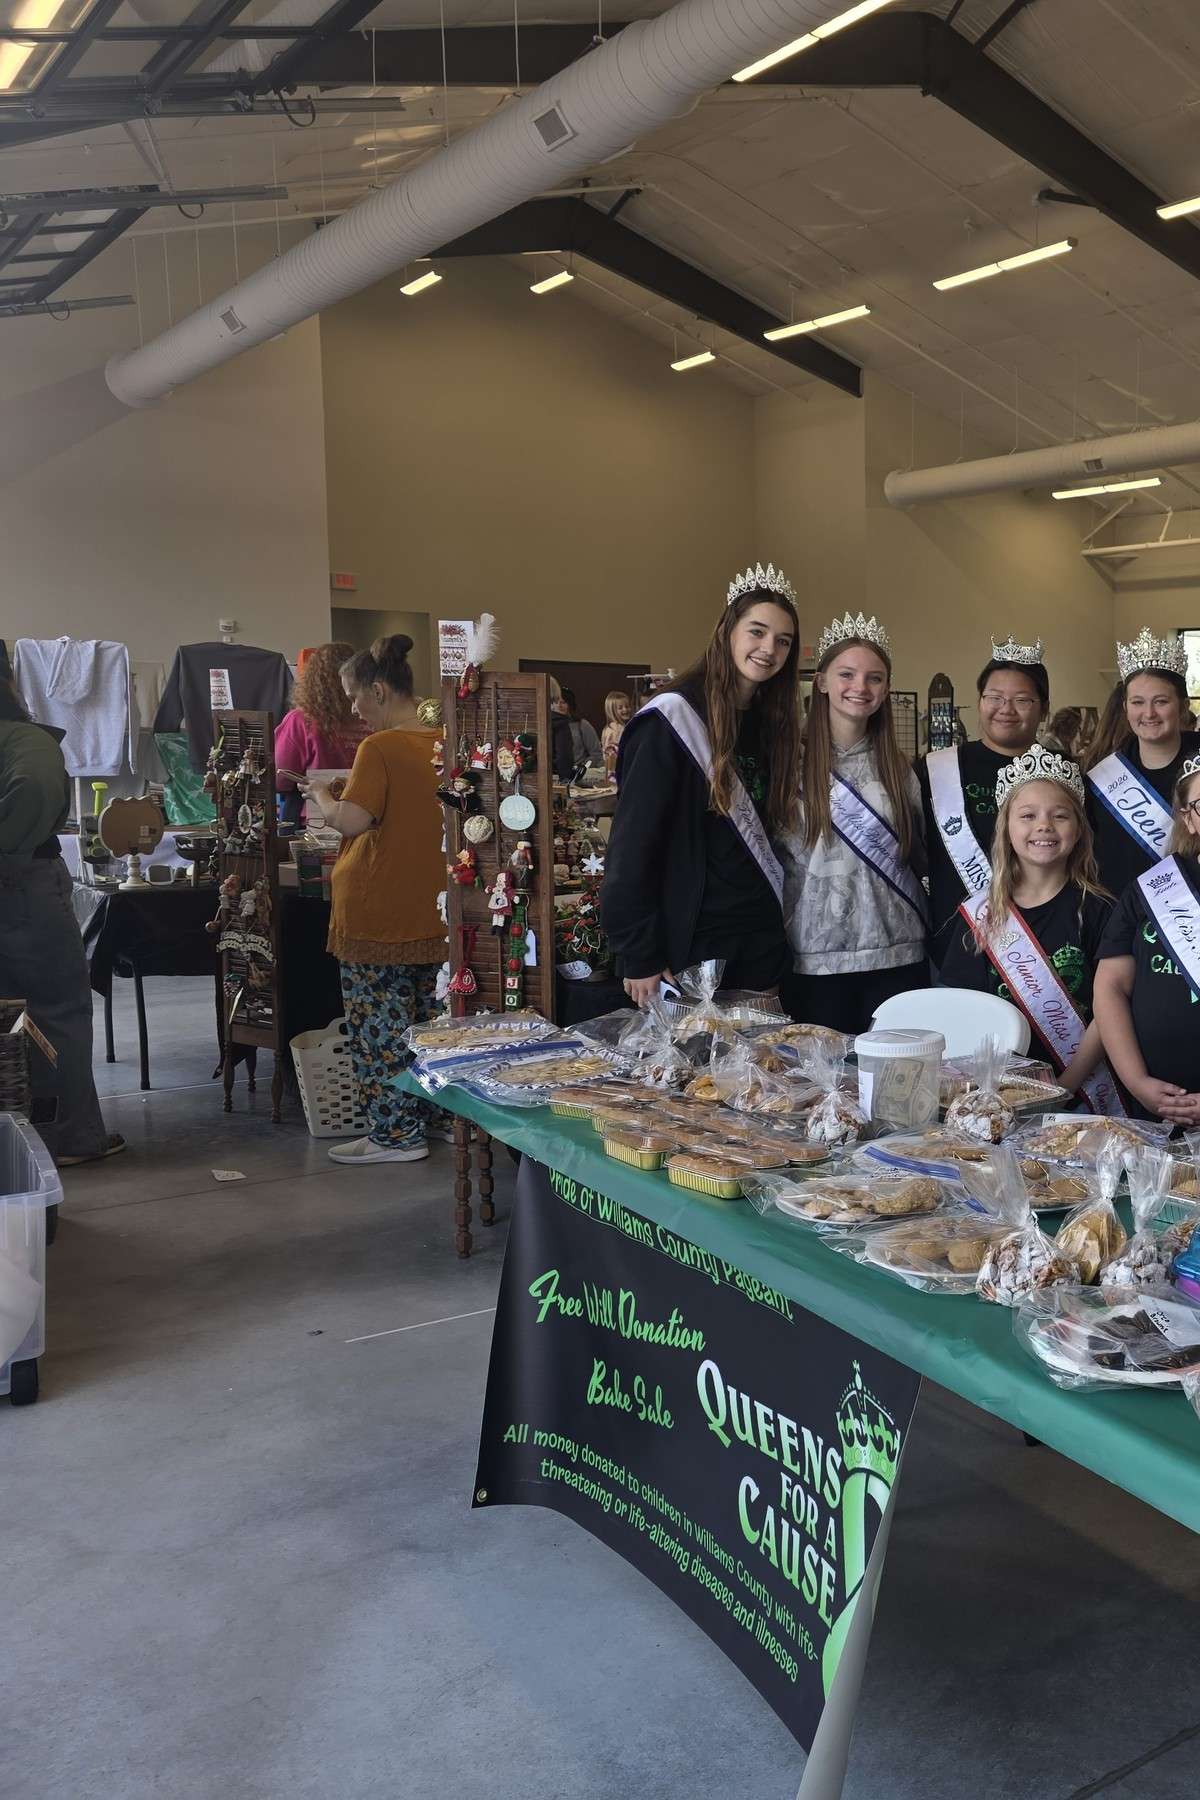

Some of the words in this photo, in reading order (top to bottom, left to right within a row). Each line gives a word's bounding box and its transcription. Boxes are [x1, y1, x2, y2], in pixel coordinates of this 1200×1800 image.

[841, 813, 865, 834] Miss
[1117, 787, 1166, 846] Teen
[962, 855, 990, 891] MISS
[1164, 900, 1197, 943] Miss
[1007, 951, 1044, 1000] Junior
[1041, 1000, 1074, 1042] Miss
[597, 1197, 655, 1248] Williams
[656, 1224, 721, 1285] County
[528, 1269, 583, 1323] Free
[583, 1281, 616, 1331] Will
[617, 1287, 706, 1351] Donation
[586, 1357, 633, 1413] Bake
[633, 1375, 675, 1429] Sale
[696, 1359, 843, 1509] QUEENS
[503, 1423, 529, 1443] All
[533, 1429, 579, 1463] money
[581, 1443, 626, 1486] donated
[627, 1471, 639, 1494] to
[641, 1484, 681, 1529] children
[683, 1511, 693, 1537] in
[694, 1522, 735, 1574] Williams
[736, 1560, 774, 1618] County
[775, 1601, 796, 1641] with
[798, 1623, 819, 1661] life-
[738, 1475, 836, 1630] CAUSE
[780, 1471, 820, 1541] FOR
[823, 1516, 837, 1561] A
[540, 1458, 613, 1513] threatening
[614, 1497, 628, 1519] or
[628, 1503, 690, 1573] life-altering
[691, 1554, 735, 1612] diseases
[732, 1599, 756, 1631] and
[755, 1615, 799, 1683] illnesses
